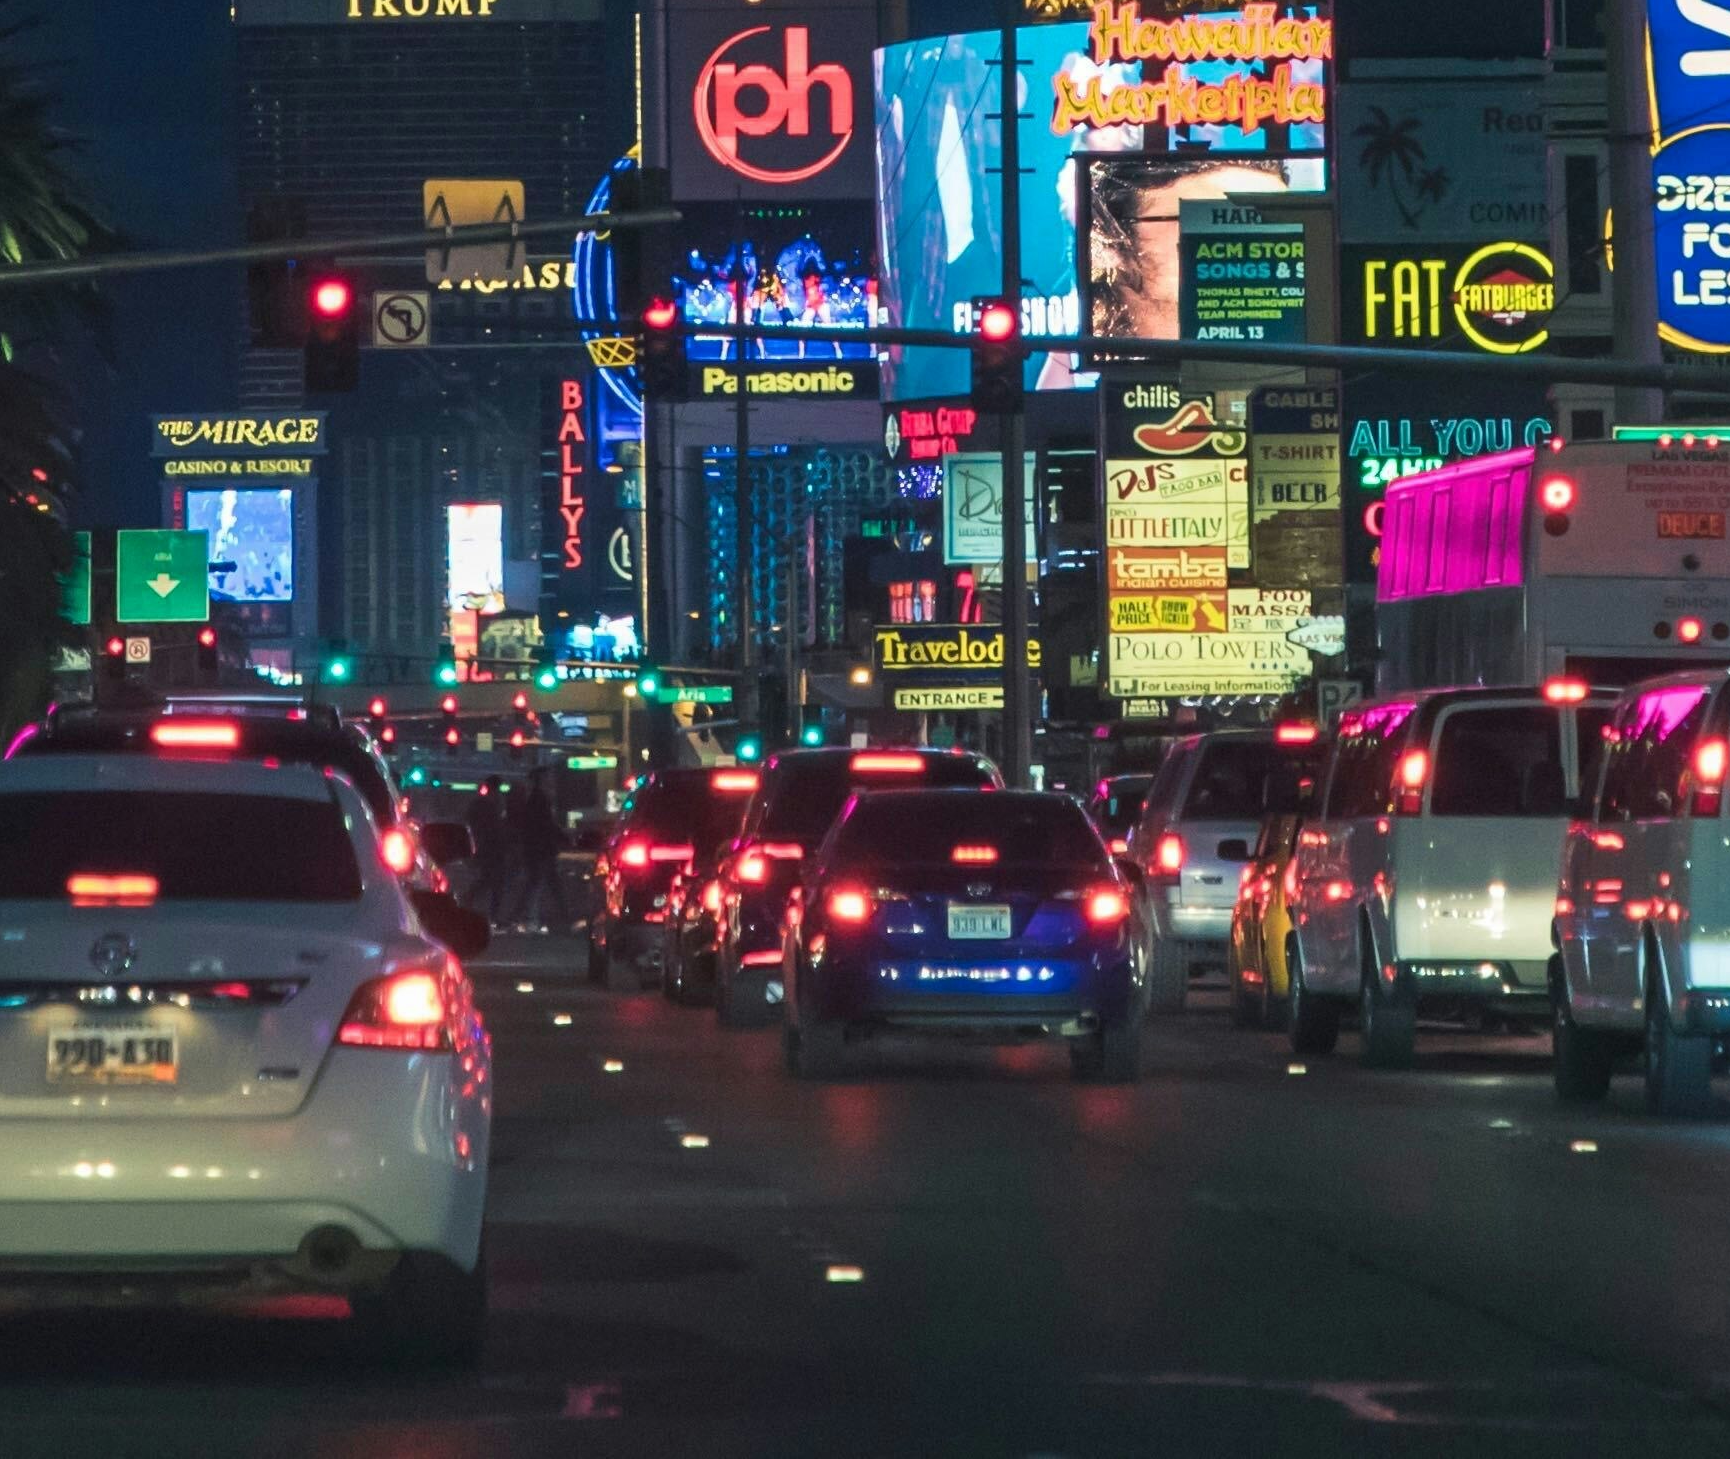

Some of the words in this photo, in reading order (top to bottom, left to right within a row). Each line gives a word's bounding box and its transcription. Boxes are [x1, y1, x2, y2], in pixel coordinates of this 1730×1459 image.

[1196, 242, 1243, 259] ACM
[1196, 262, 1271, 280] SONGS
[1275, 261, 1291, 279] &
[1197, 287, 1241, 297] THOMAS
[1365, 260, 1446, 338] FAT
[1197, 298, 1220, 308] AND
[1222, 298, 1245, 308] ACM
[1197, 310, 1225, 320] YEAR
[1197, 325, 1245, 340] APRIL
[1247, 325, 1265, 339] 13
[702, 365, 855, 394] Panasonic
[158, 419, 194, 436] THE
[171, 418, 319, 446] MIRAGE
[1349, 419, 1422, 457] ALL
[1430, 418, 1513, 455] YOU
[1260, 445, 1337, 462] T-SHIRT
[165, 460, 227, 476] CASINO
[229, 460, 242, 474] &
[246, 459, 313, 475] RESORT
[558, 380, 586, 570] BALLYS
[1272, 483, 1328, 504] BEER
[1659, 514, 1722, 536] DEUCE
[1112, 549, 1227, 578] tamba
[1118, 601, 1149, 613] HALF
[1117, 613, 1152, 625] PRICE
[876, 630, 1042, 664] Travelode
[1114, 635, 1183, 661] POLO
[1189, 634, 1297, 660] TOWERS
[1141, 681, 1160, 692] For
[1163, 680, 1212, 695] Leasing
[1214, 680, 1289, 692] Information
[899, 691, 989, 707] ENTRANCE
